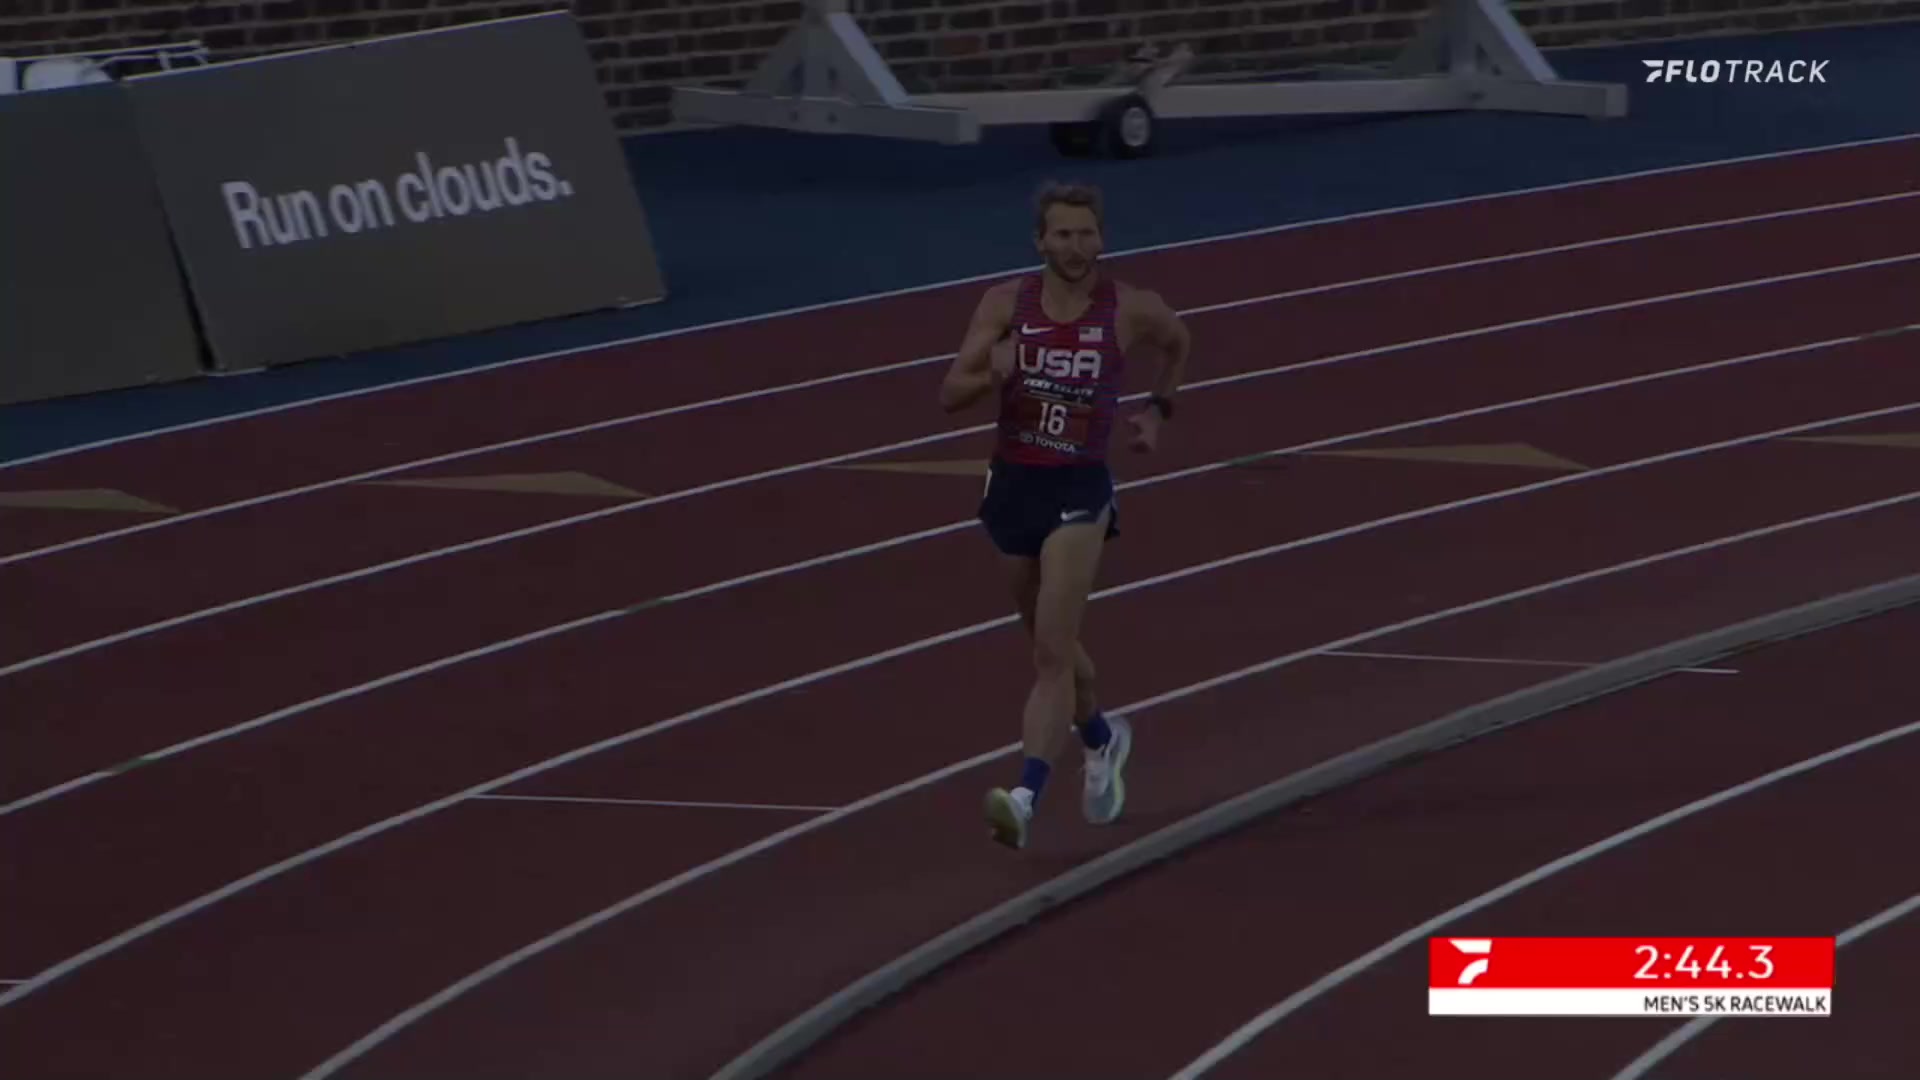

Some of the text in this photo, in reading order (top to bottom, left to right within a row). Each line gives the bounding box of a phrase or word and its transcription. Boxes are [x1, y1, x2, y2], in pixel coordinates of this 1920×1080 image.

[221, 136, 575, 249] Run on clouds.
[1019, 343, 1101, 379] USA
[1039, 402, 1067, 436] 16
[1035, 435, 1076, 454] TOYOTA
